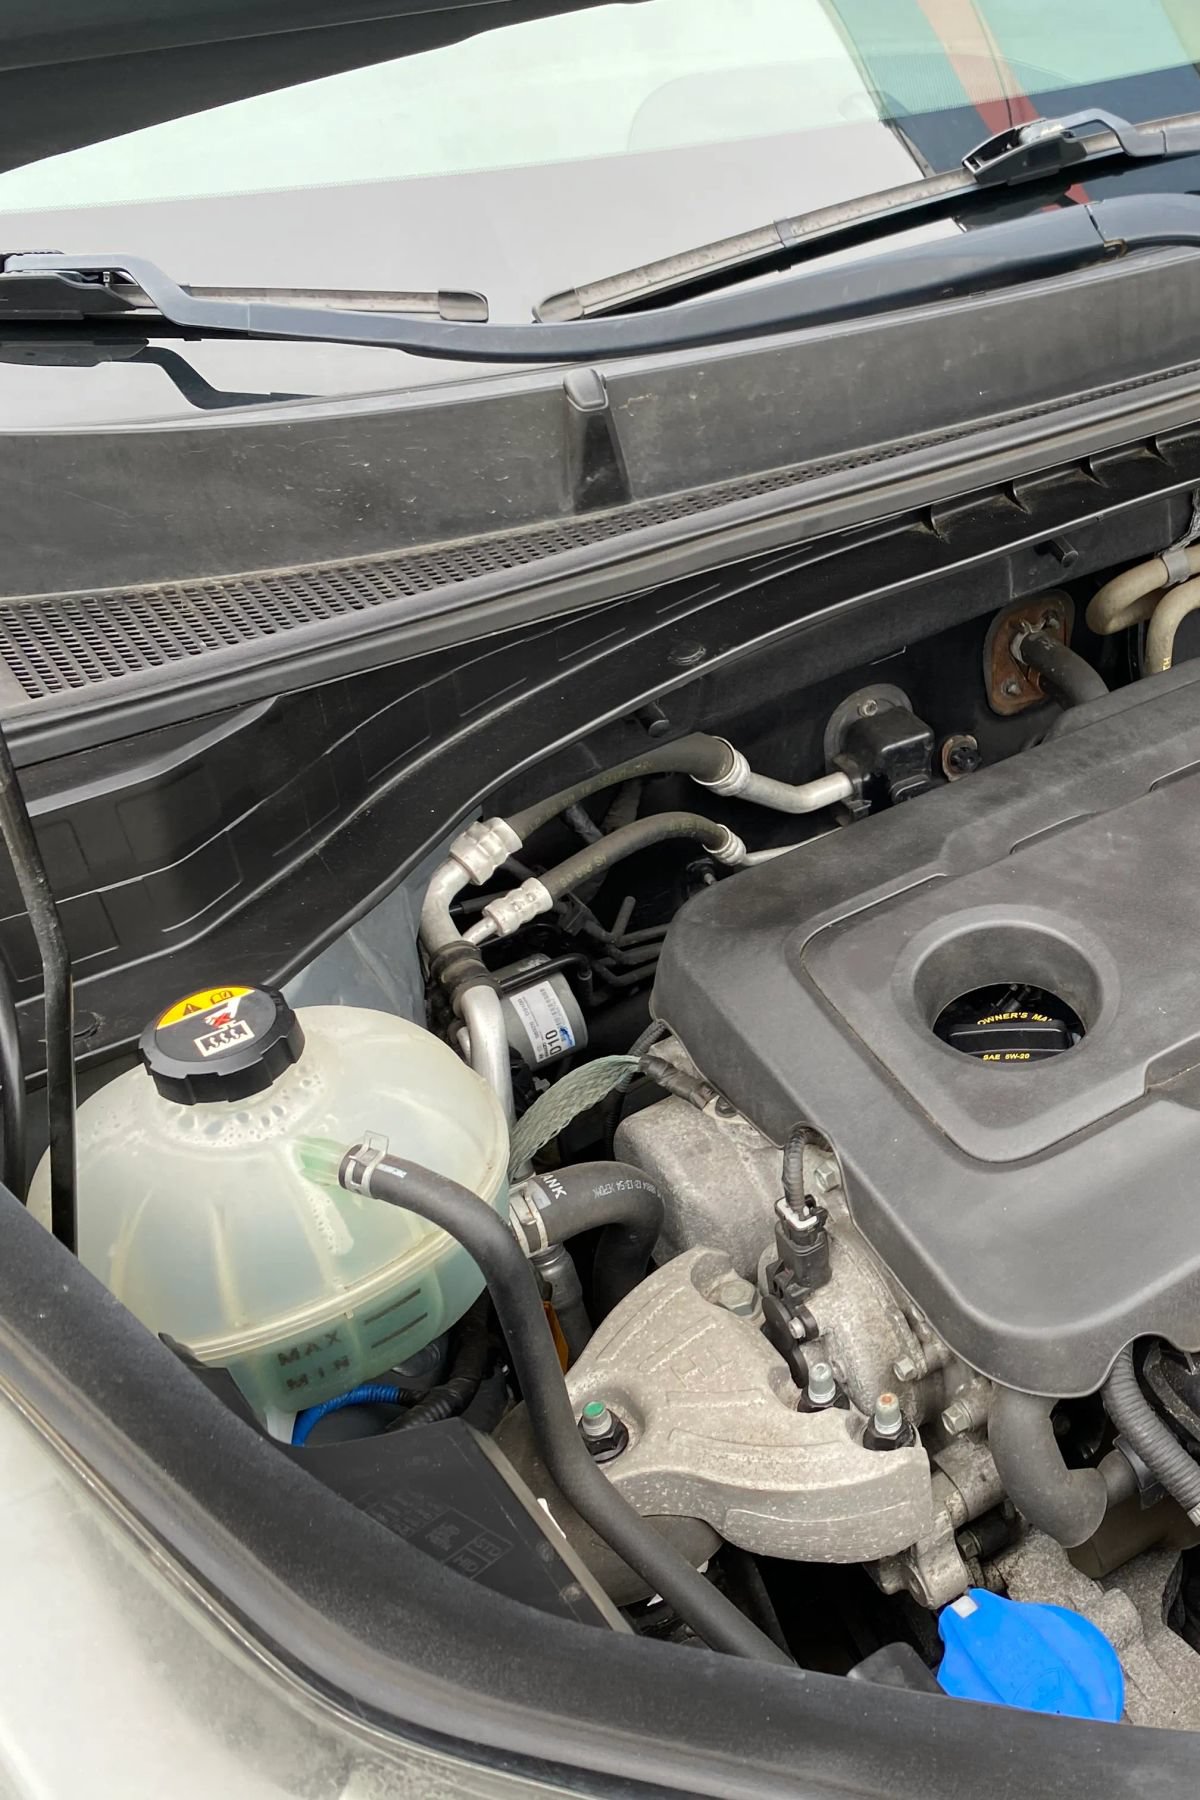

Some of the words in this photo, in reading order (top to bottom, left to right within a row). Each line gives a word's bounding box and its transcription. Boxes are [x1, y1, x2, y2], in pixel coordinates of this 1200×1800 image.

[977, 1012, 1028, 1025] OWNER'S
[983, 1053, 1001, 1061] SAE
[1005, 1052, 1030, 1060] 5W-20
[541, 1174, 567, 1199] ANK
[278, 1330, 342, 1366] MAX
[286, 1355, 351, 1391] MIN
